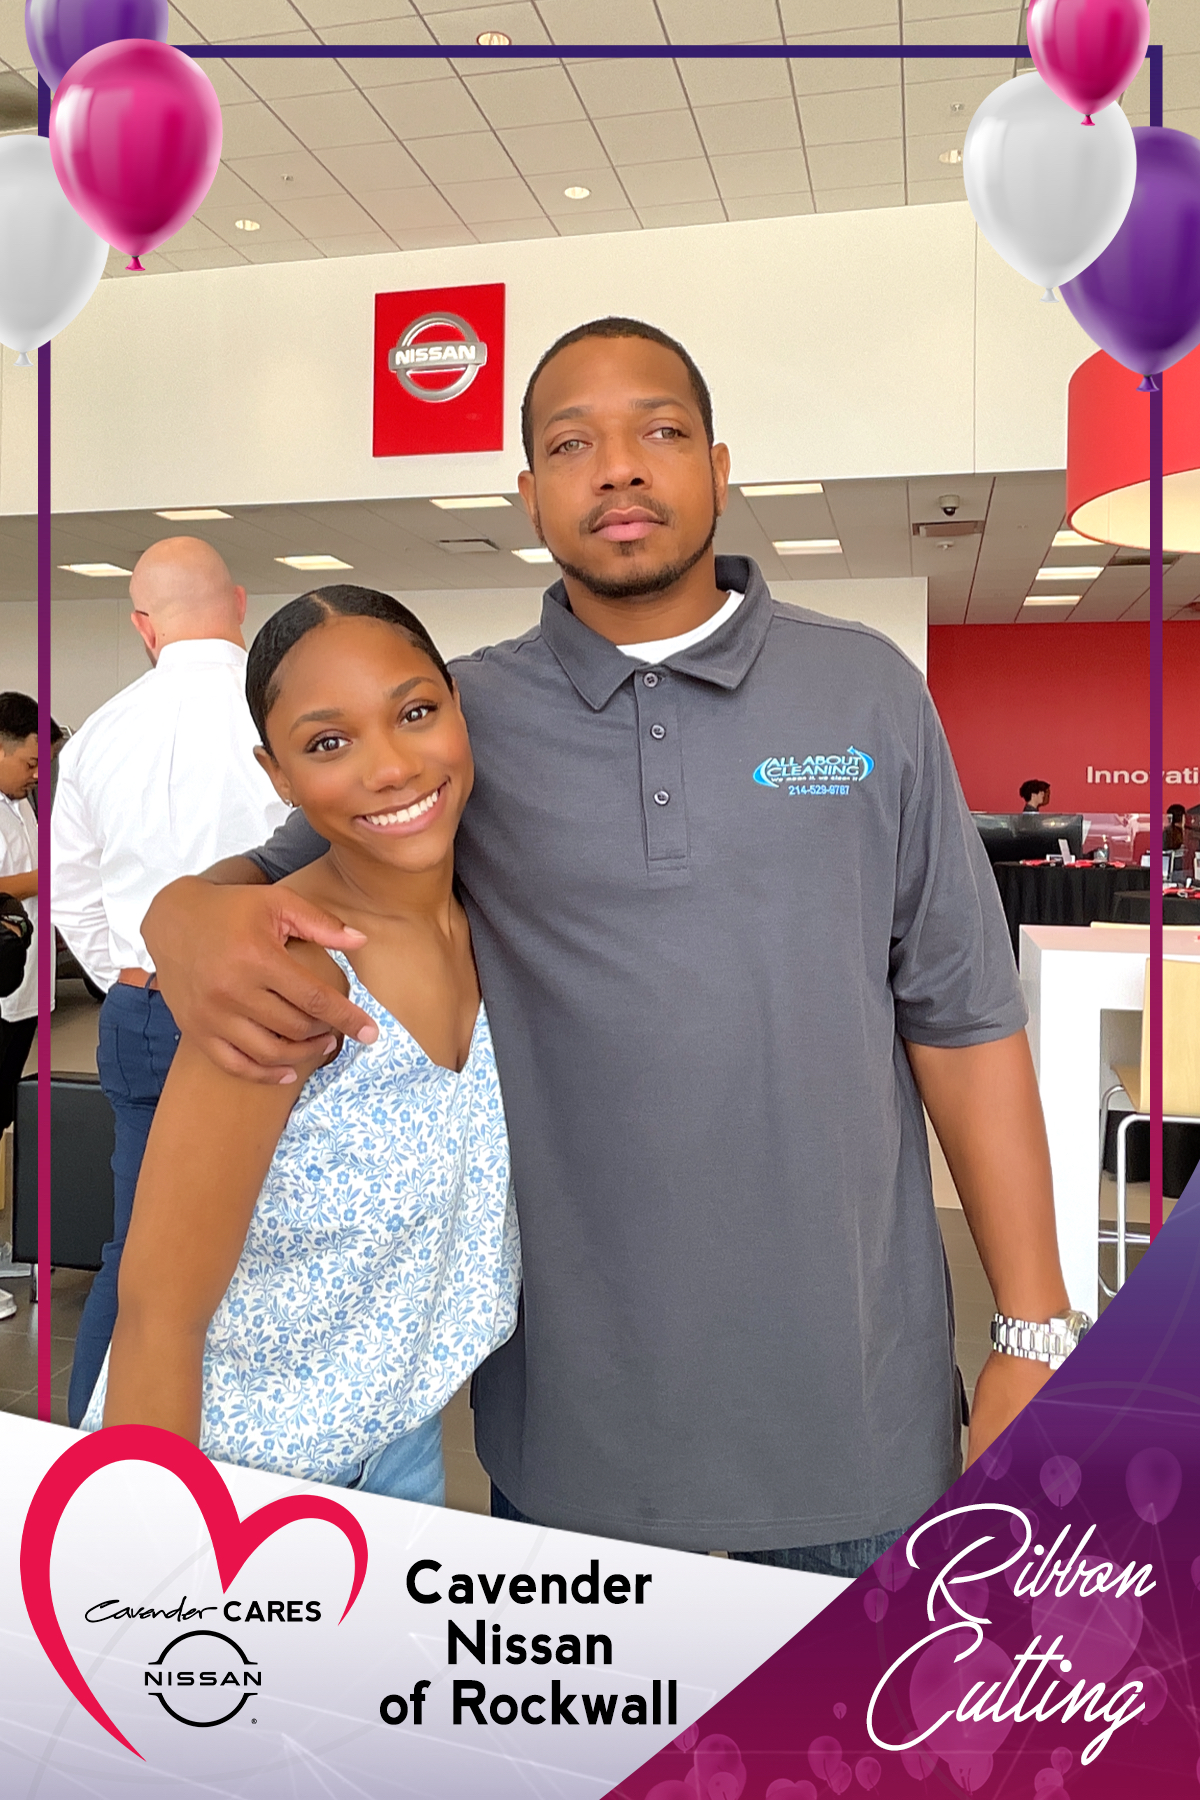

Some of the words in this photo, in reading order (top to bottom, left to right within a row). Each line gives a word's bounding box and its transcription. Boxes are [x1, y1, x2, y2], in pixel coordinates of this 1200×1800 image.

[395, 345, 476, 365] NISSAN
[767, 757, 798, 767] ALL
[802, 755, 861, 766] ABOUT
[767, 765, 859, 776] CLEANING
[1086, 766, 1199, 785] Innoati
